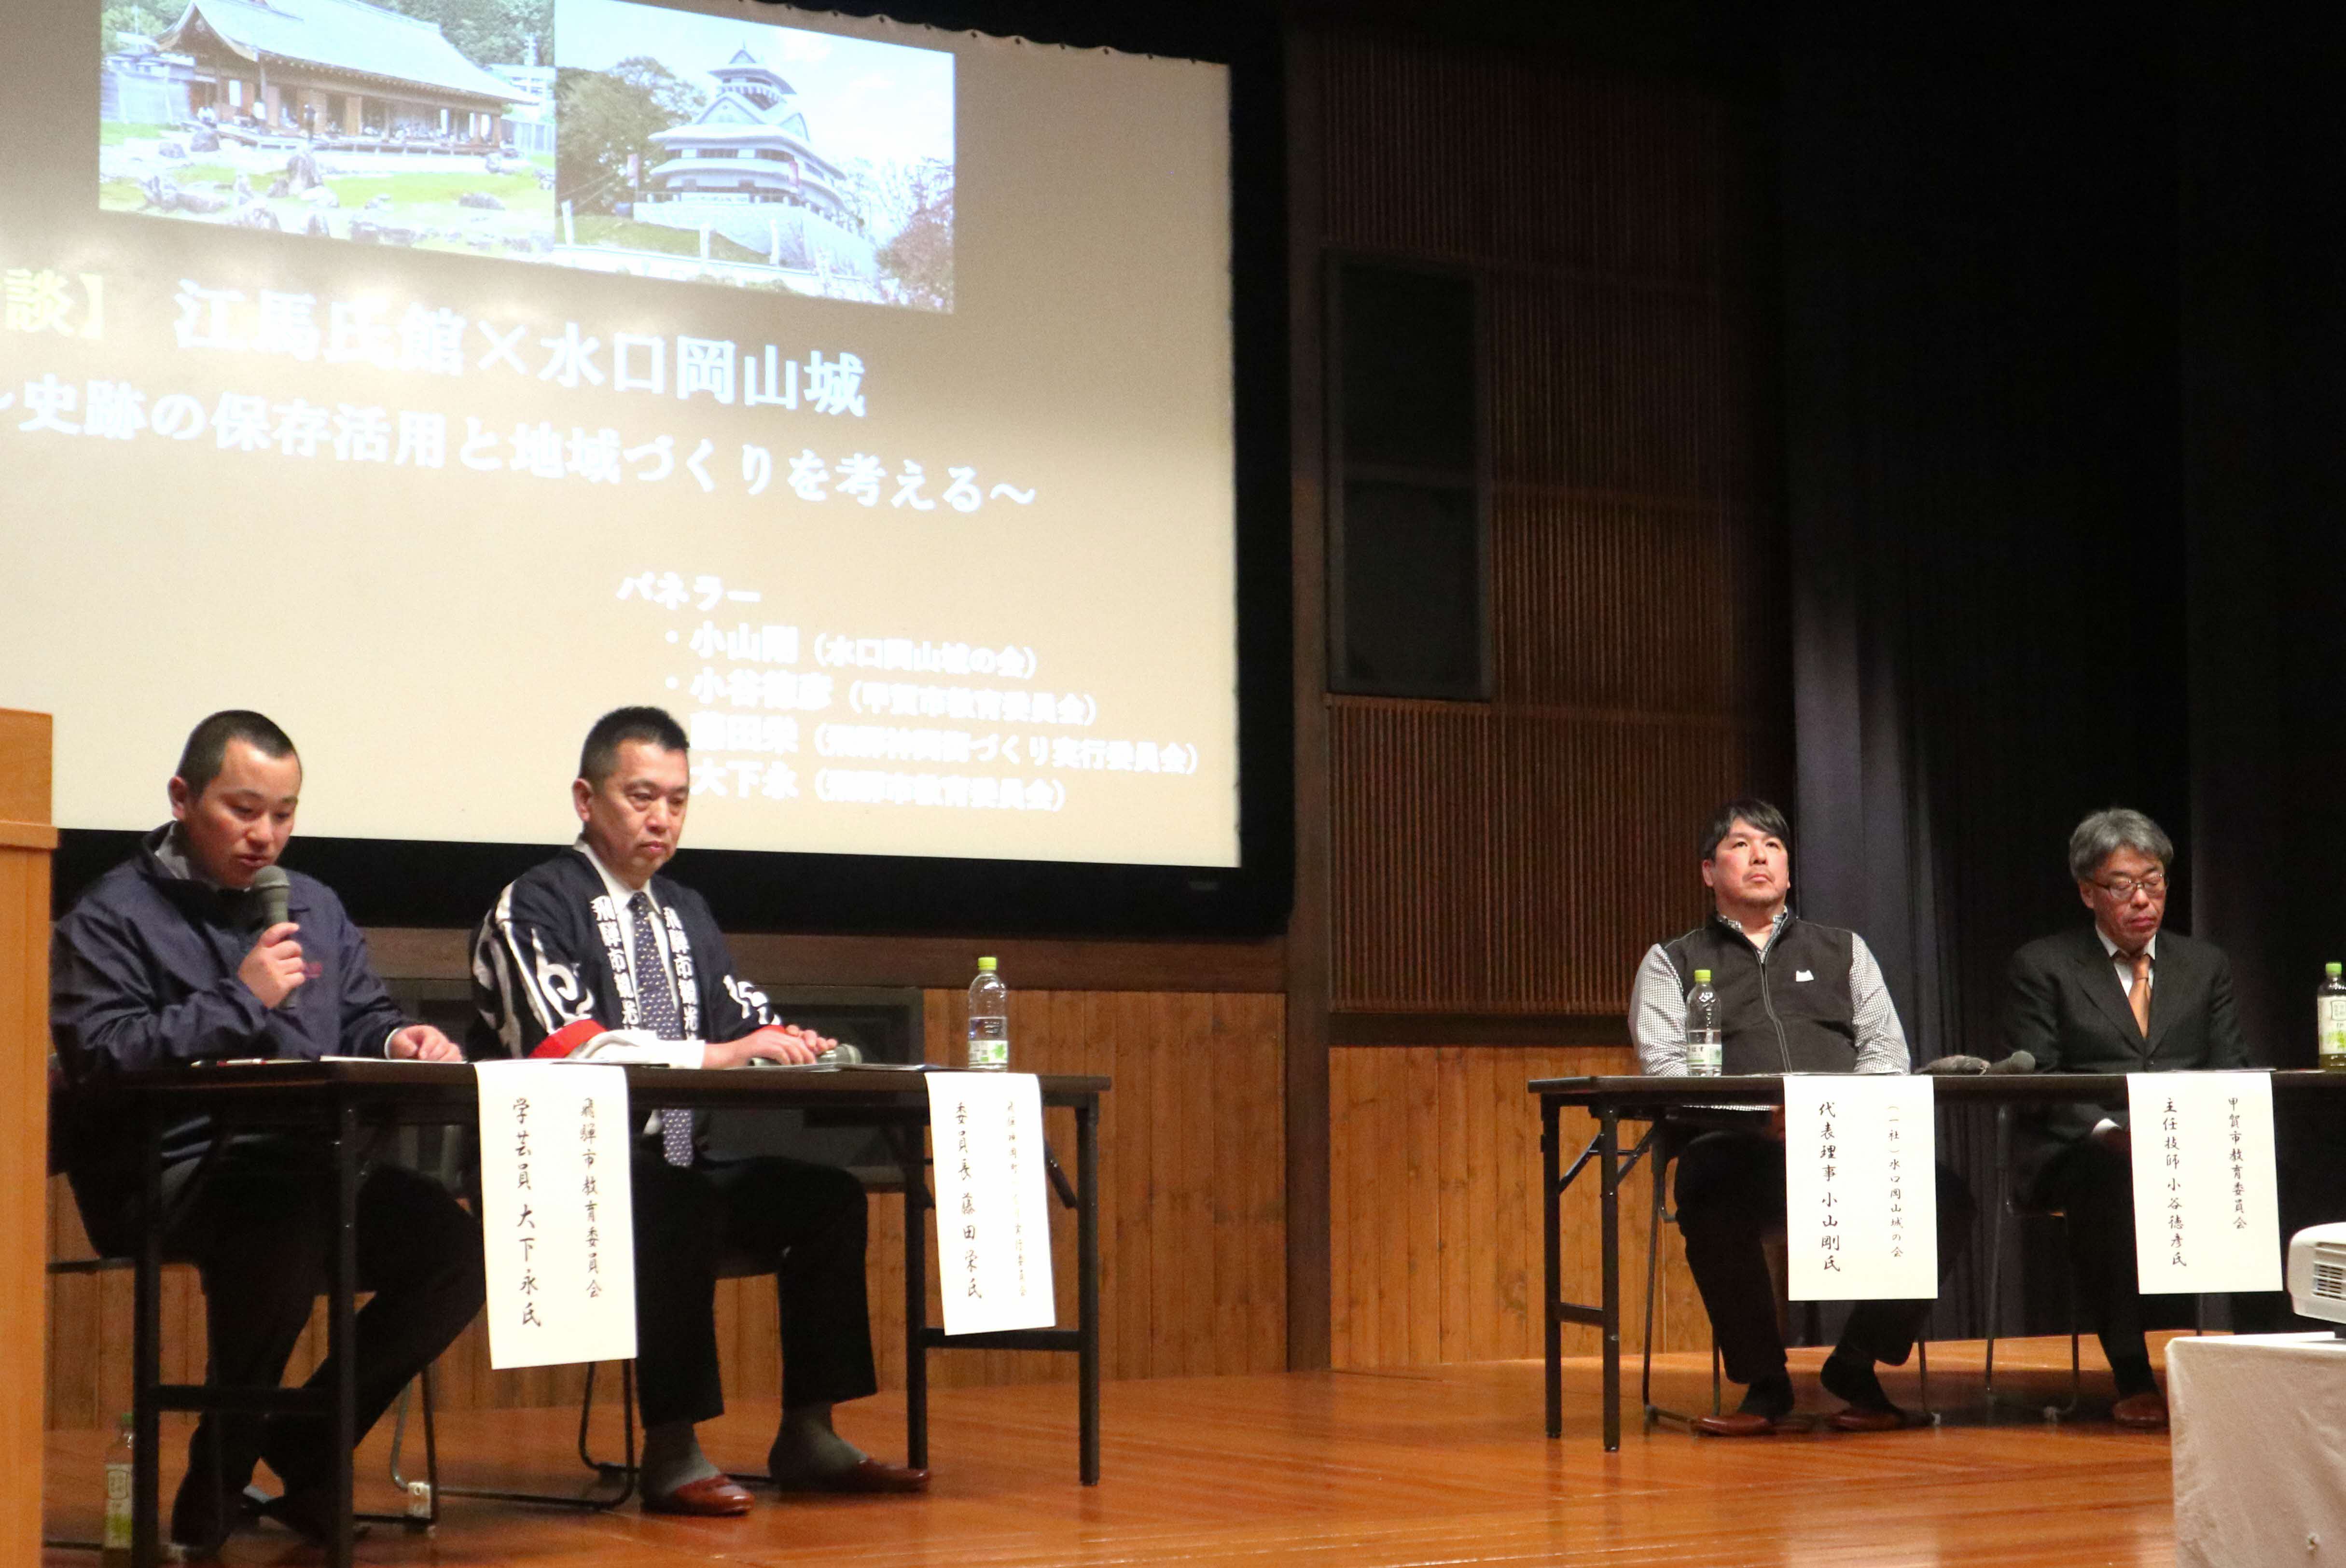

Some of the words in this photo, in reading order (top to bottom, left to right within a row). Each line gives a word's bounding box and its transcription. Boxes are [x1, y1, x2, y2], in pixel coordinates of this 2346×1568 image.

[2228, 1097, 2248, 1230] 甲賀市教育委員会
